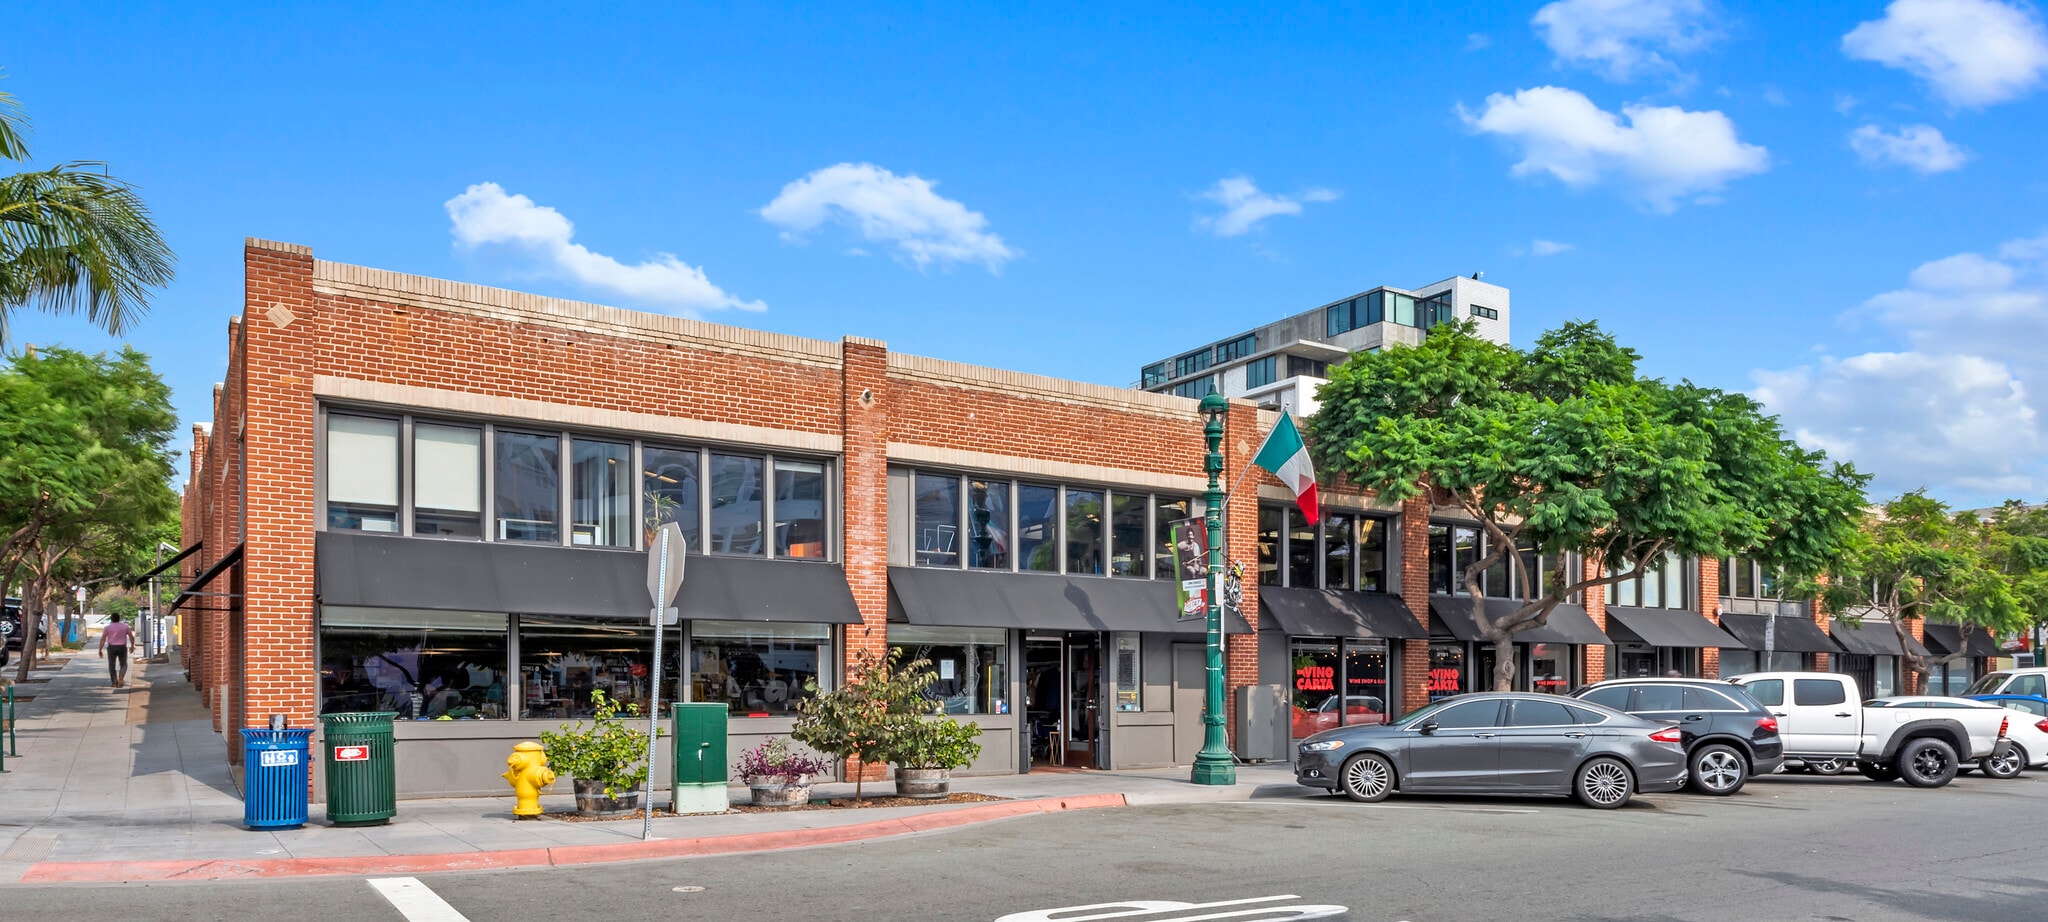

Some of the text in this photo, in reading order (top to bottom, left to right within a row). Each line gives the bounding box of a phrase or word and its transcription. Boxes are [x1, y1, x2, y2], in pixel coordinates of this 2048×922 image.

[1303, 666, 1334, 679] VINO
[1432, 668, 1459, 680] VINO
[1296, 678, 1335, 690] CARTA
[1428, 679, 1460, 690] CARTA
